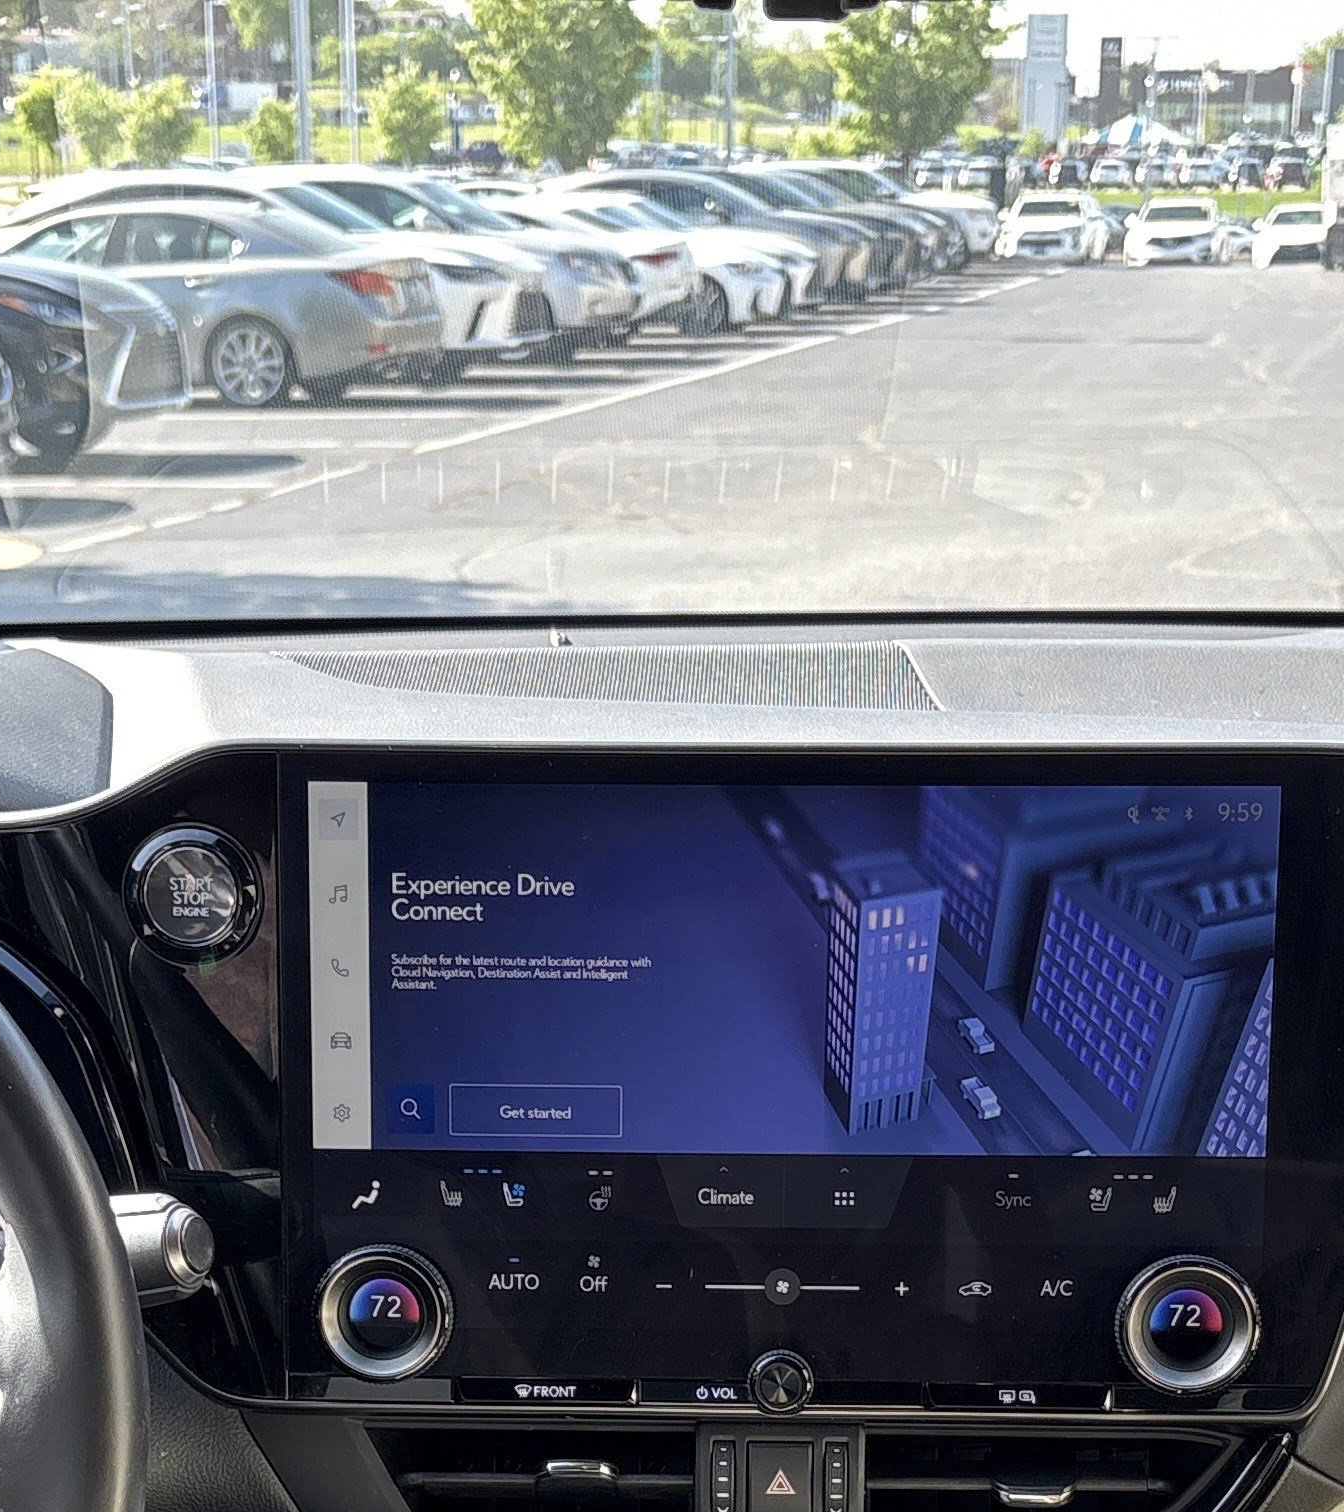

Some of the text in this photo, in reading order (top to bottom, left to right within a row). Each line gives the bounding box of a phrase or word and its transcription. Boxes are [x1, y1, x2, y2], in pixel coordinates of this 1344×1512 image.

[1217, 802, 1263, 823] 9:59
[169, 876, 214, 892] START
[390, 872, 575, 900] Experience Drive
[172, 891, 211, 905] STOP
[172, 906, 210, 918] ENGINE
[390, 898, 484, 922] Connect
[390, 953, 652, 970] Subscribe for the latest route and location guidance with
[390, 966, 628, 982] Cloud Navigation, Destination Assist and Intelligent
[390, 978, 438, 991] Assistant.
[499, 1105, 572, 1121] Get started
[697, 1188, 756, 1208] Climate
[994, 1190, 1032, 1211] Sync
[488, 1273, 540, 1292] AUTO
[579, 1275, 609, 1293] Off
[1040, 1279, 1074, 1299] A/C
[370, 1295, 402, 1319] 72
[1169, 1304, 1202, 1327] 72
[532, 1384, 577, 1399] FRONT
[711, 1386, 738, 1400] VOL
